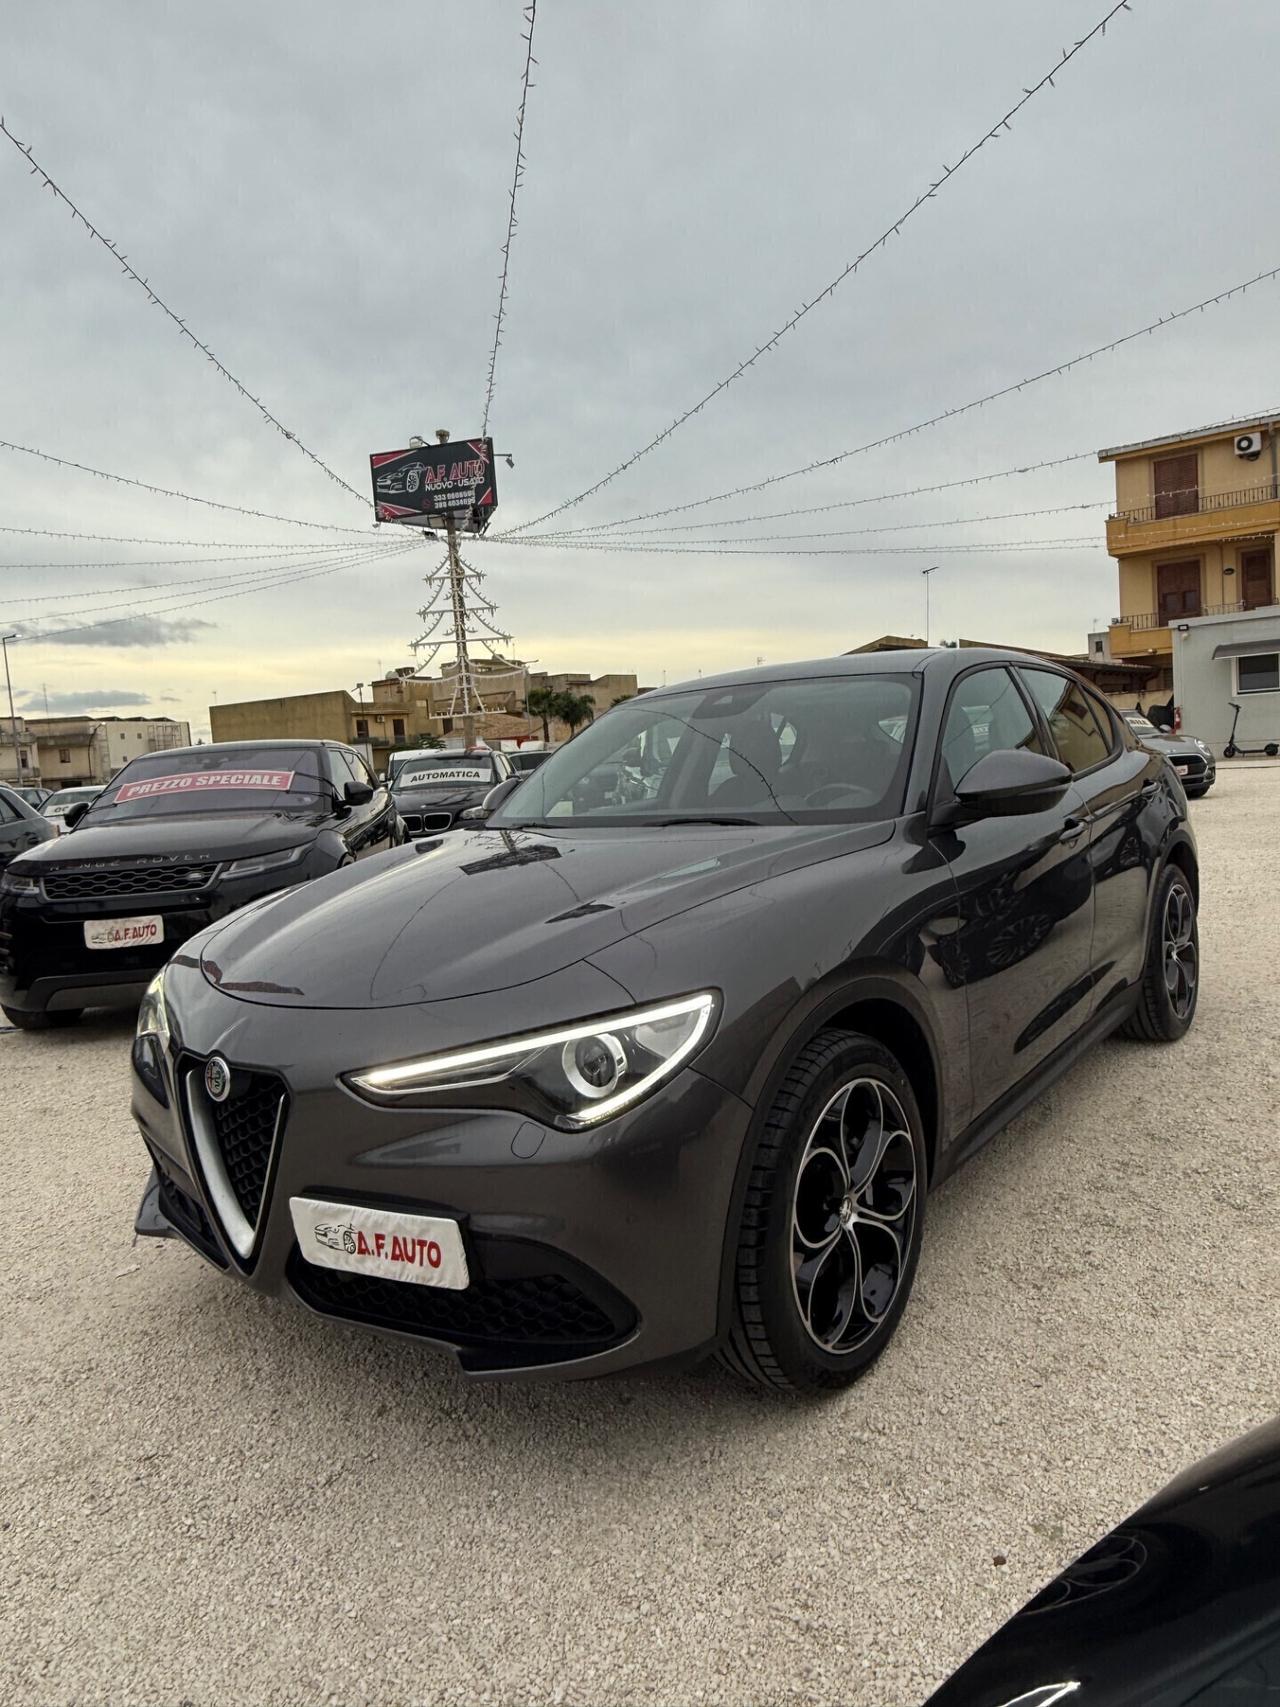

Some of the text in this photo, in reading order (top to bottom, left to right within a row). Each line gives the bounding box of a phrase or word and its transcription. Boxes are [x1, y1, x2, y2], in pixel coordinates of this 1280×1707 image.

[425, 480, 453, 491] NUOVO
[410, 771, 480, 782] AUTOMATICA
[127, 774, 282, 797] PREZZO SPECIALE
[49, 860, 121, 872] RNGE
